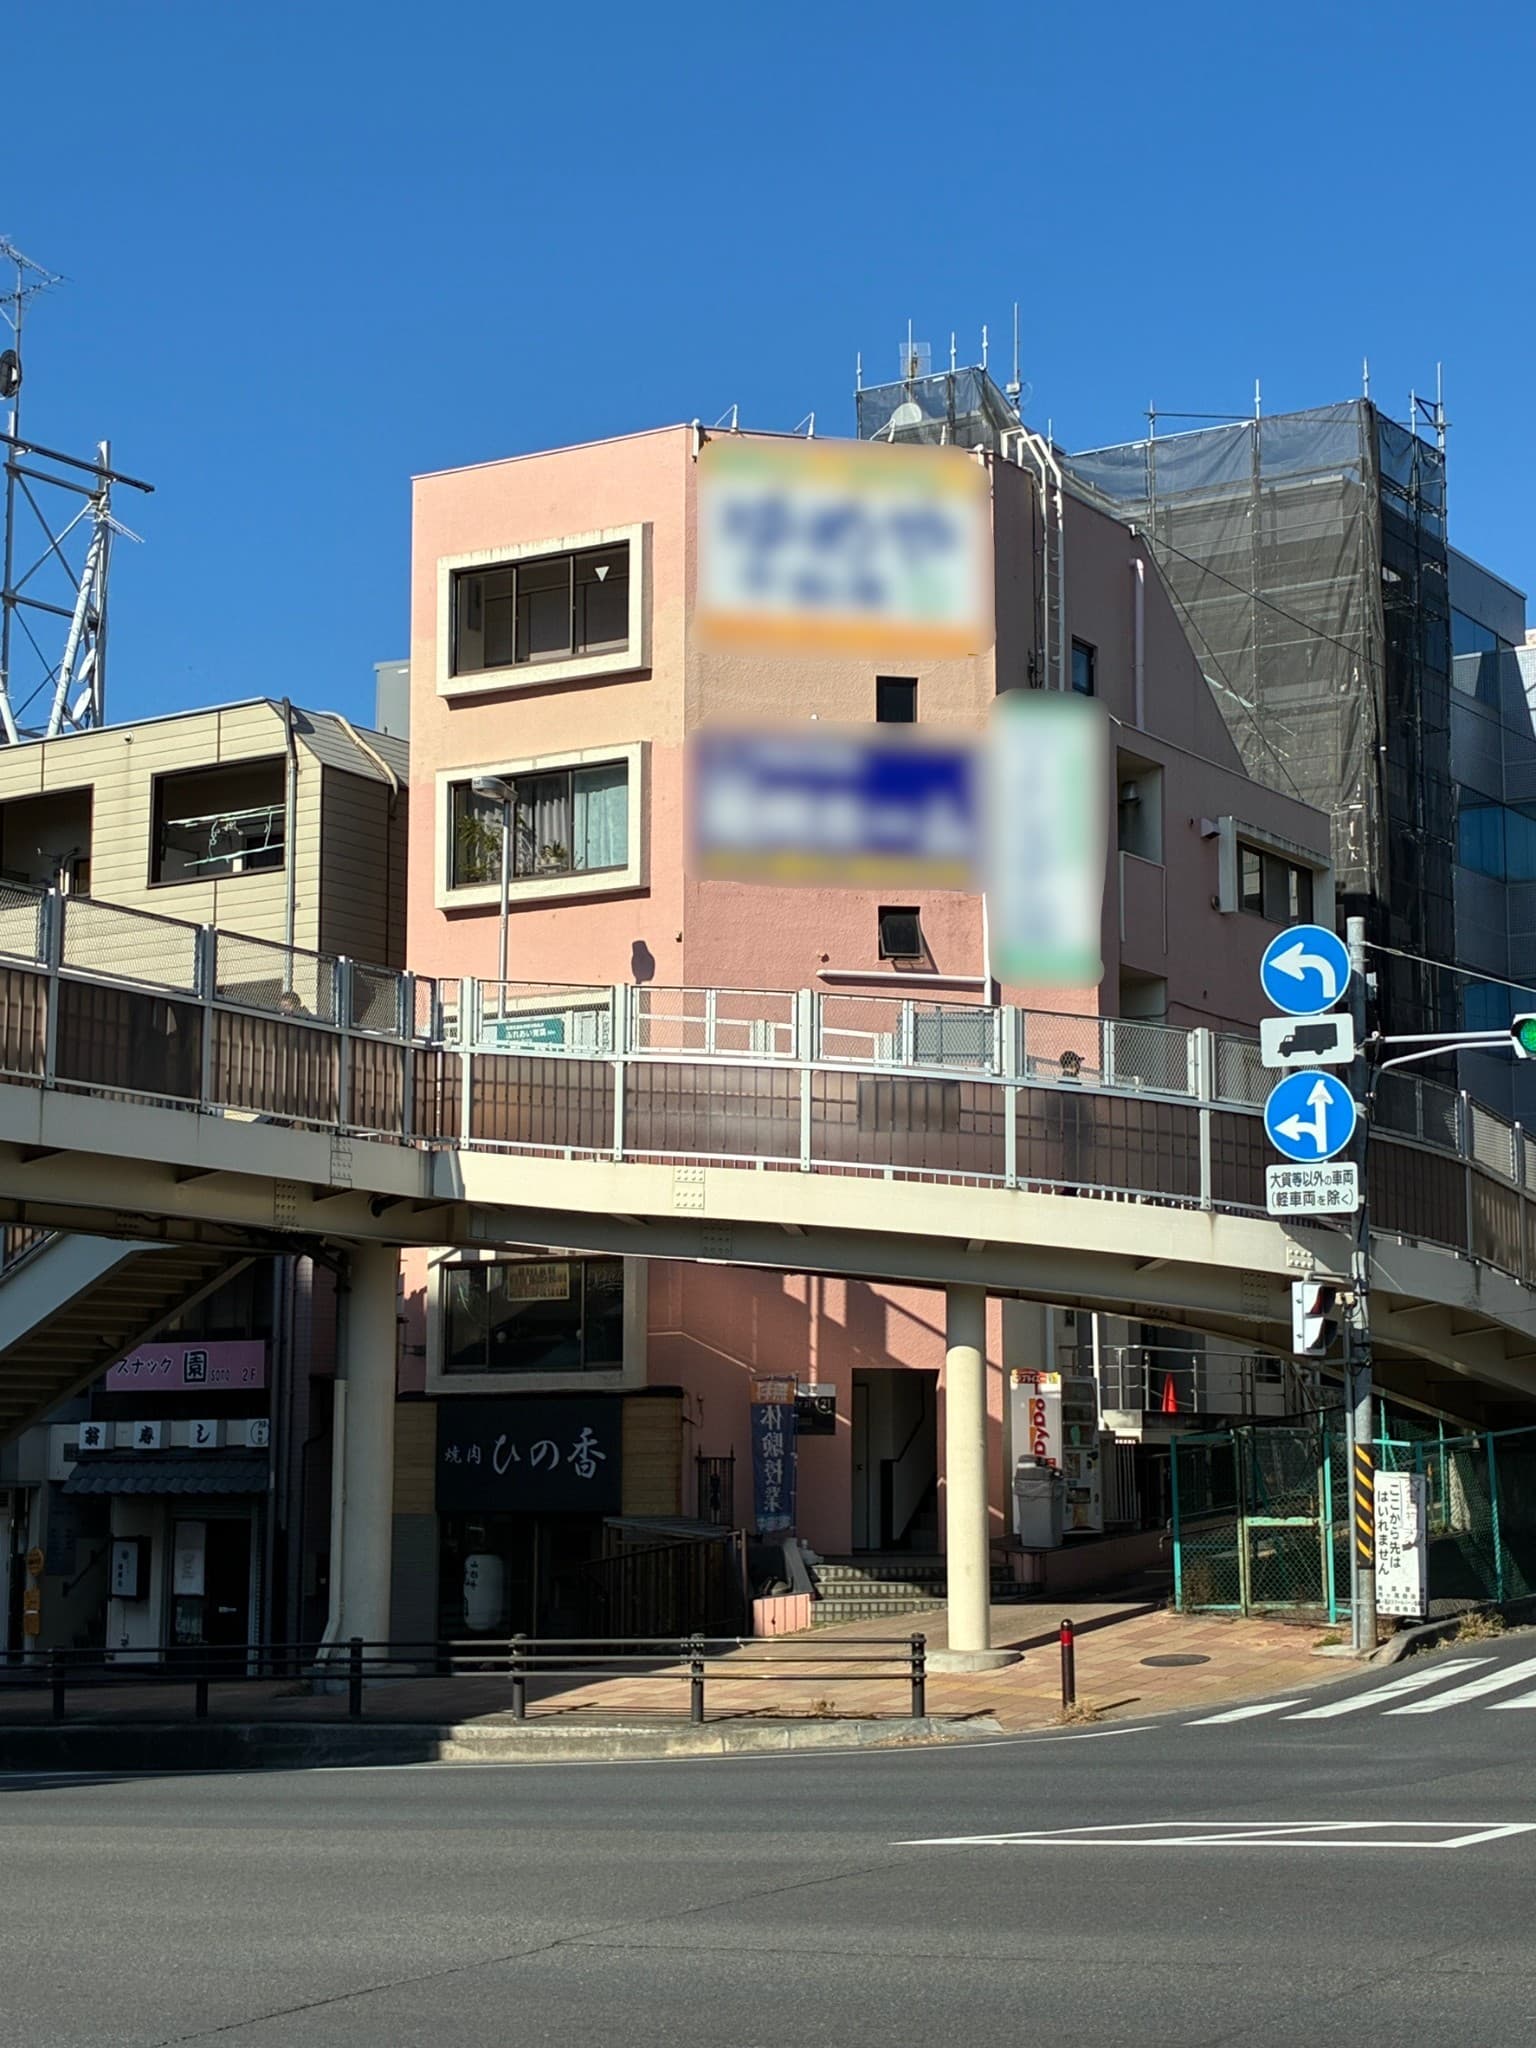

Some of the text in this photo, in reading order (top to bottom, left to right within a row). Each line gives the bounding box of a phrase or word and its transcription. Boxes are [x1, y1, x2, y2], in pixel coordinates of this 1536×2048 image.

[1270, 1169, 1354, 1188] 大貨等以外の車両
[117, 1358, 172, 1375] スナック
[242, 1368, 256, 1382] 2F
[444, 1427, 607, 1479] 焼肉 ひの香
[1034, 1398, 1050, 1456] DyDo
[1377, 1490, 1389, 1576] はいれません
[1389, 1484, 1401, 1569] ここから先は
